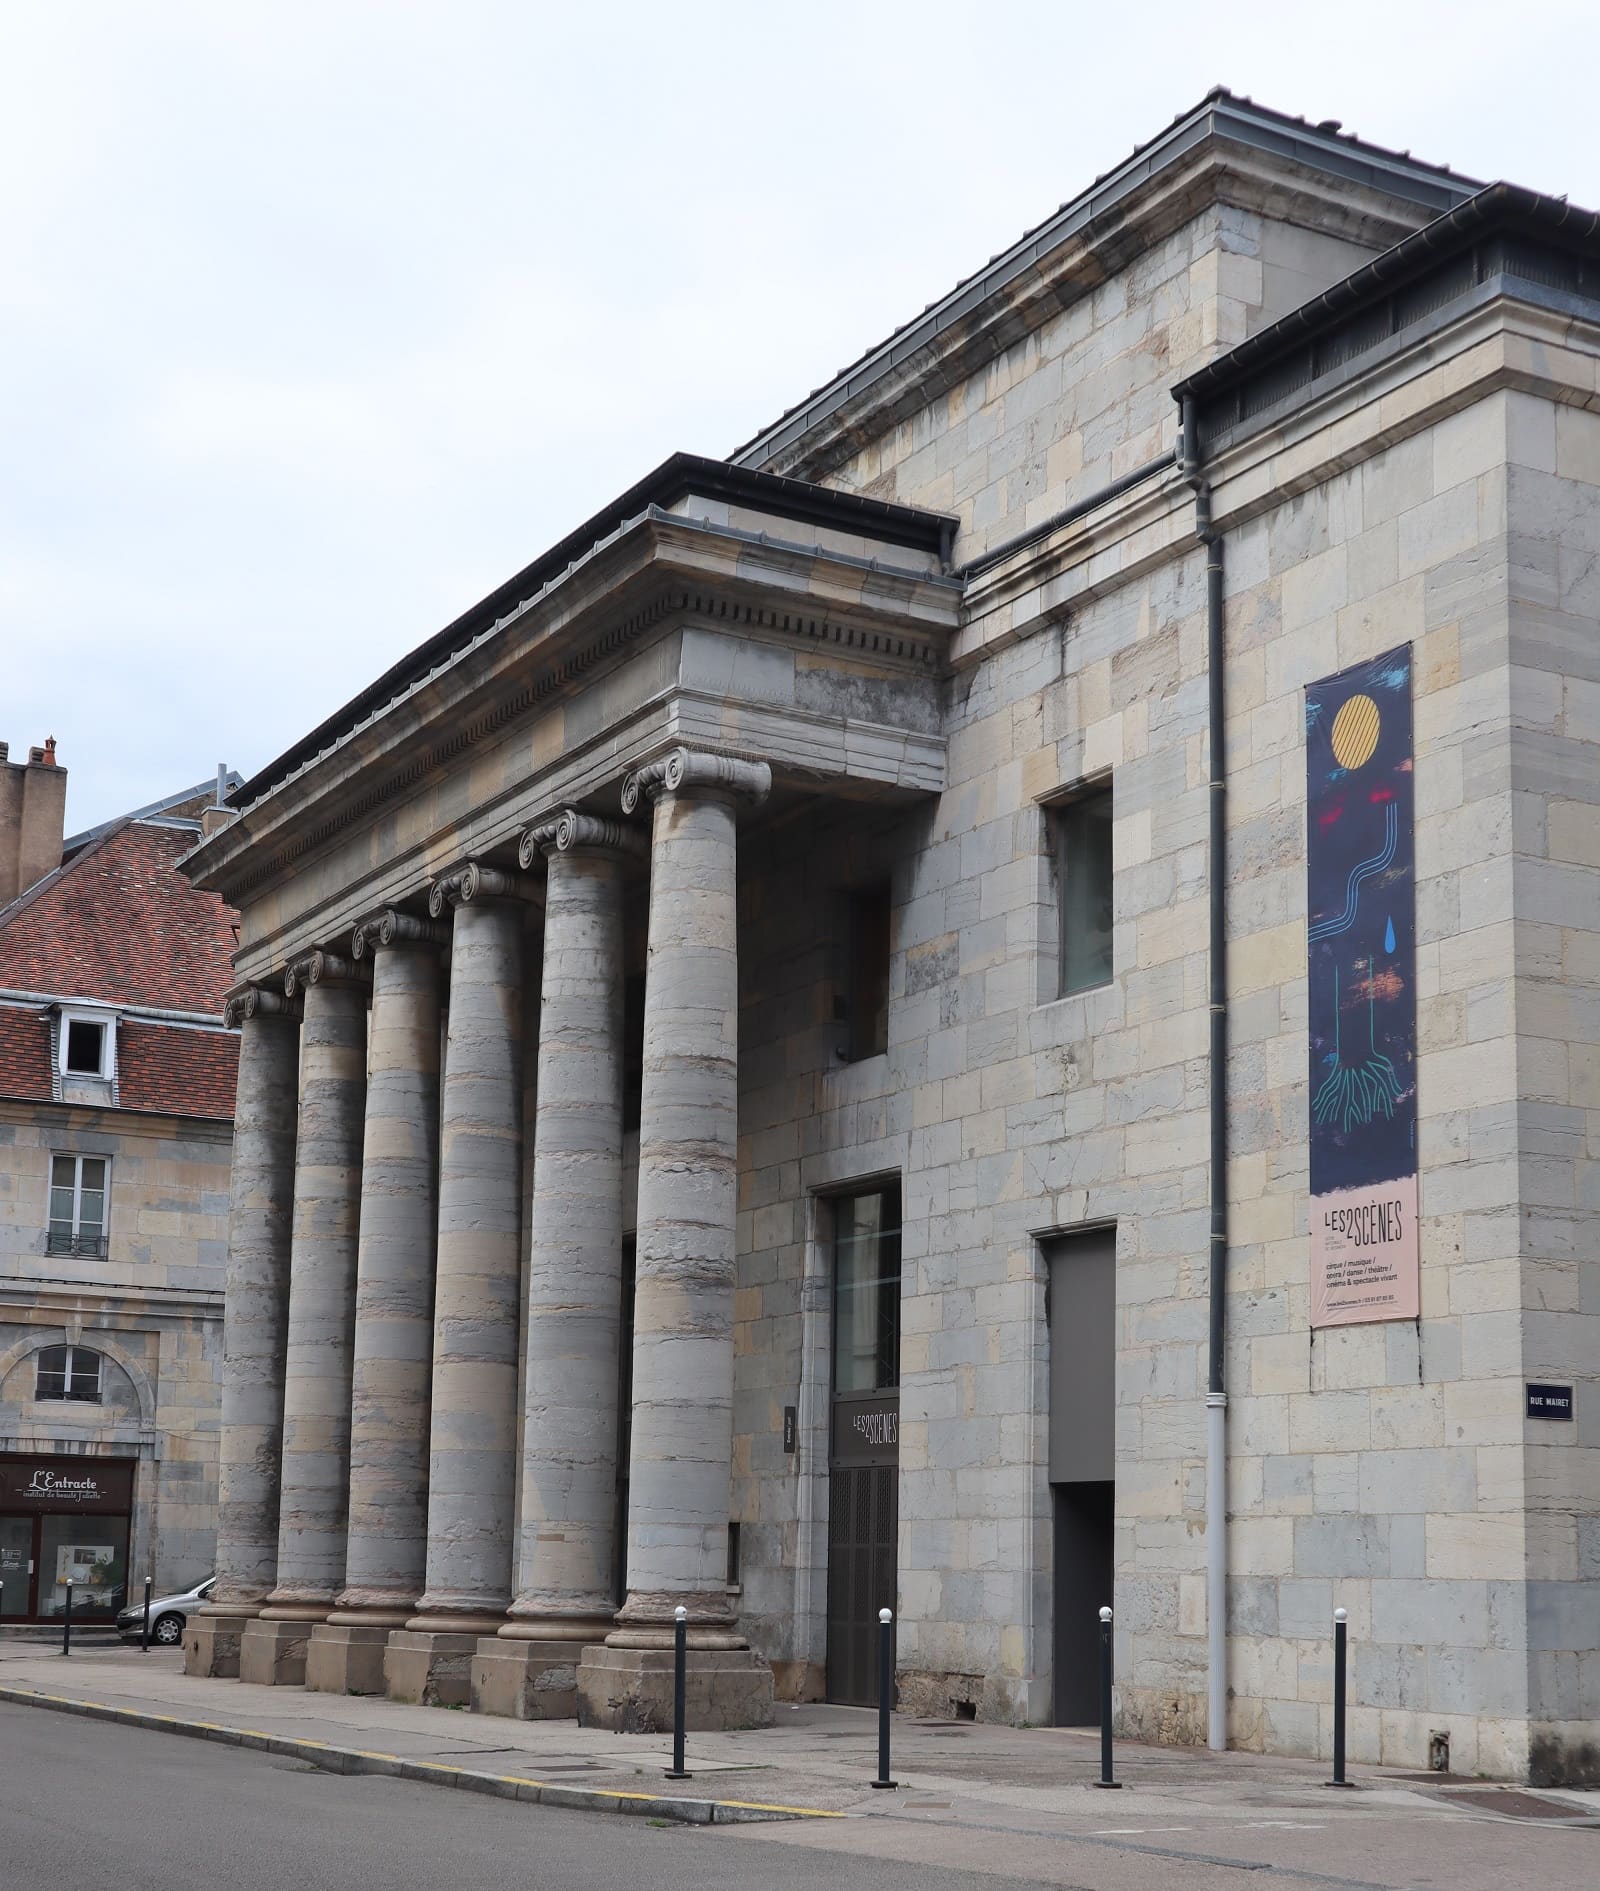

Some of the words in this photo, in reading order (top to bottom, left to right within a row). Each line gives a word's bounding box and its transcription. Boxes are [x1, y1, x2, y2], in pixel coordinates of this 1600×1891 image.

[1347, 1259, 1372, 1267] musique
[1346, 1269, 1364, 1277] danse
[1353, 1276, 1379, 1286] spectacle
[1530, 1397, 1543, 1406] RUE
[1546, 1398, 1569, 1407] MAIRET
[28, 1470, 97, 1491] L'Entracte
[22, 1490, 45, 1498] institut
[46, 1490, 55, 1498] de
